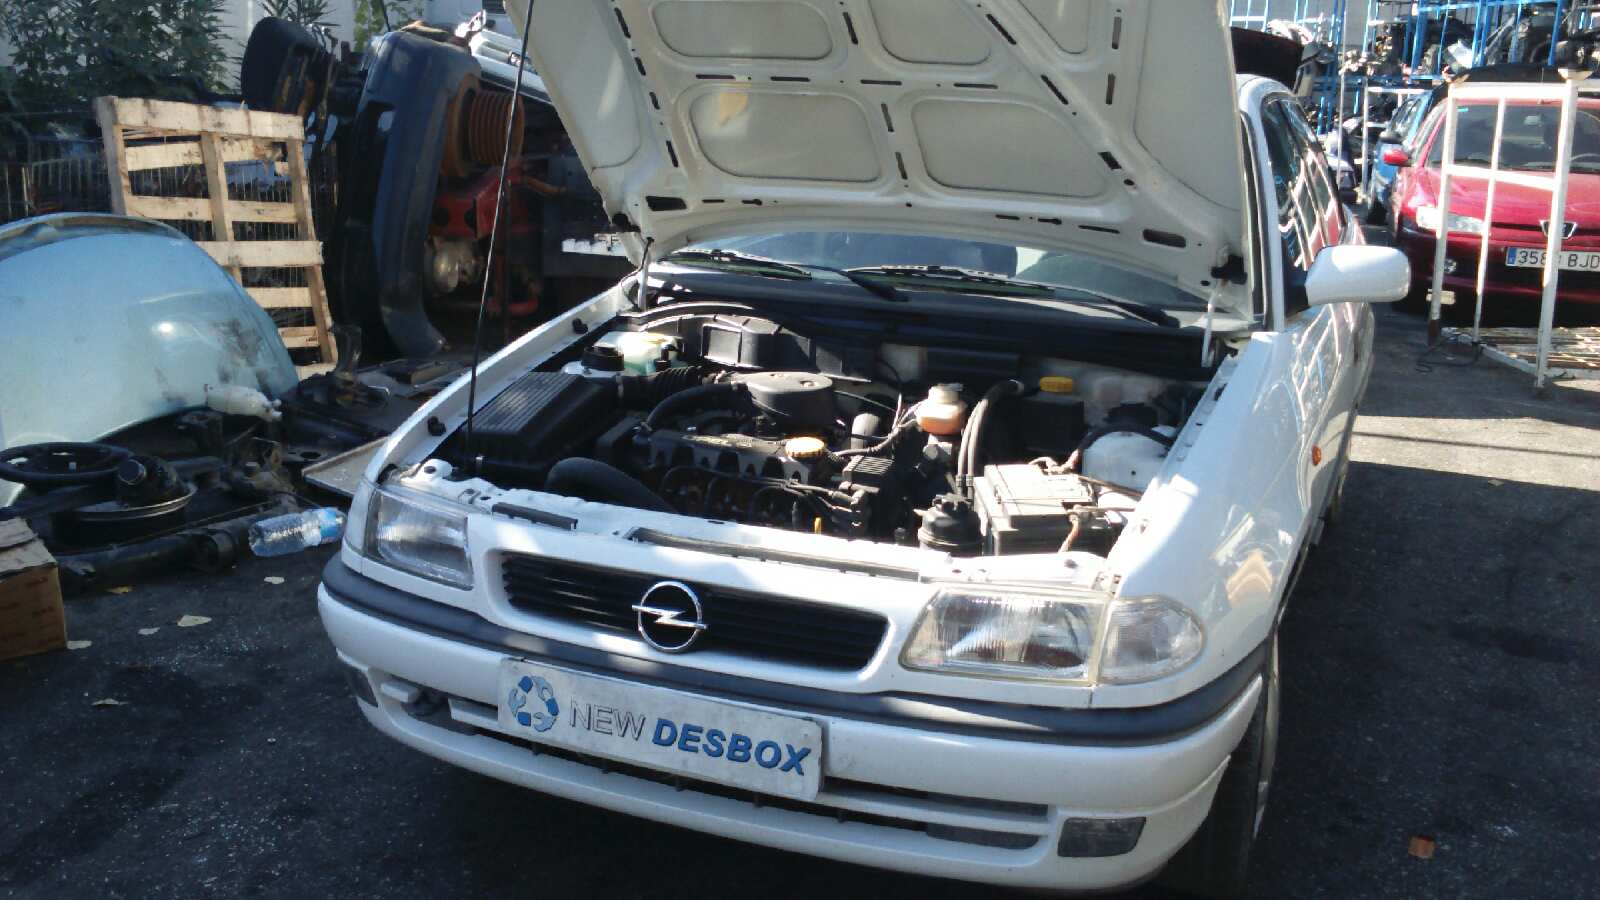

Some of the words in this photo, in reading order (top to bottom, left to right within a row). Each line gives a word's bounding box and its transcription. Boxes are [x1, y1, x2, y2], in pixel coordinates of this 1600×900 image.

[1518, 250, 1562, 266] 358
[1567, 253, 1600, 269] BJD
[571, 698, 646, 741] NEW
[652, 718, 811, 775] DESBOX
